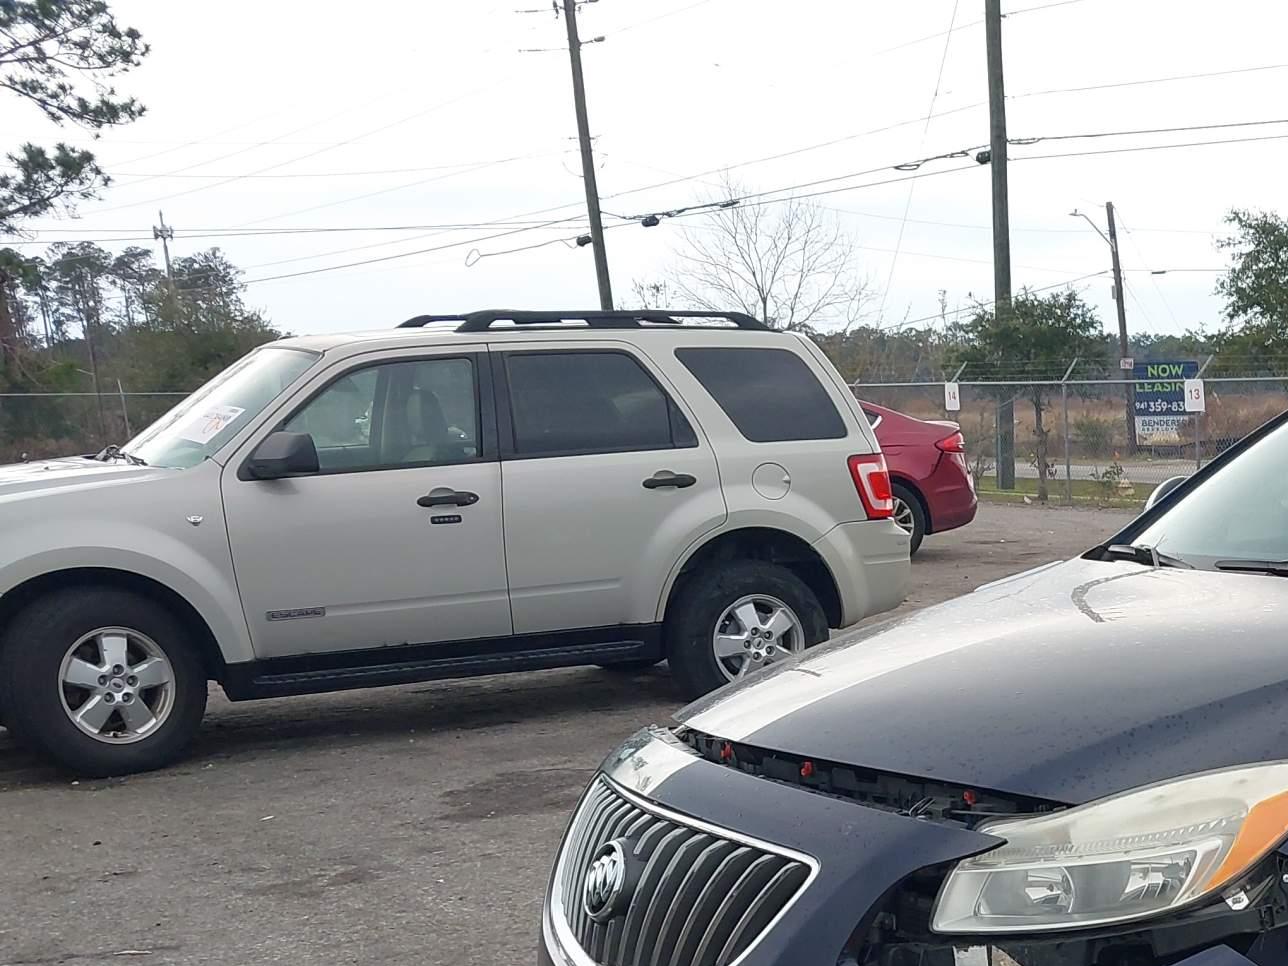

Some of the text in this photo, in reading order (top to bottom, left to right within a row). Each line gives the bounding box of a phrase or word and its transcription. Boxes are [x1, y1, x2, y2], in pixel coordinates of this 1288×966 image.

[1147, 364, 1184, 378] NOW
[1135, 381, 1184, 392] LEASIN
[948, 391, 957, 401] 14
[1188, 388, 1201, 401] 13
[1148, 400, 1184, 412] 359-83
